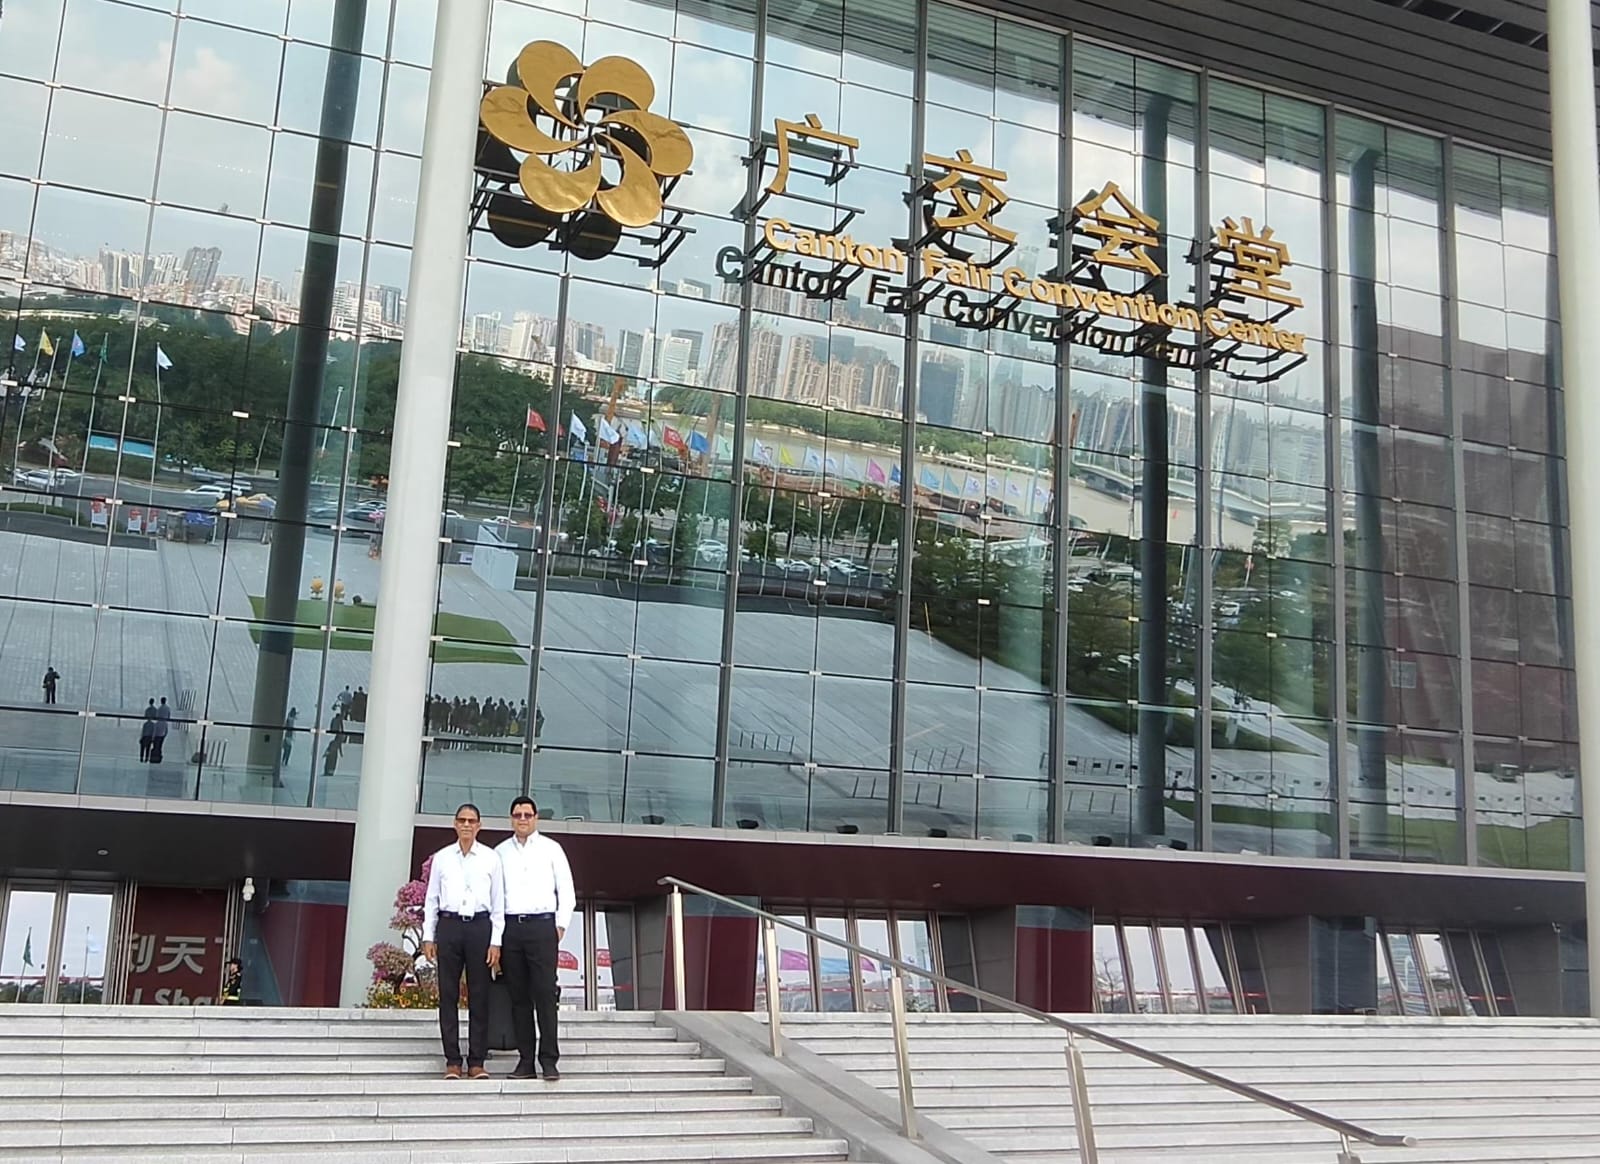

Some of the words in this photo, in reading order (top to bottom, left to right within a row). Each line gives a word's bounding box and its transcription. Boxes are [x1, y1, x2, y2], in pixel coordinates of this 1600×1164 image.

[764, 218, 905, 273] Canton
[922, 249, 993, 291] Fair
[1002, 266, 1201, 331] Convention
[1203, 306, 1307, 352] Center
[765, 114, 1304, 308] 广交会堂
